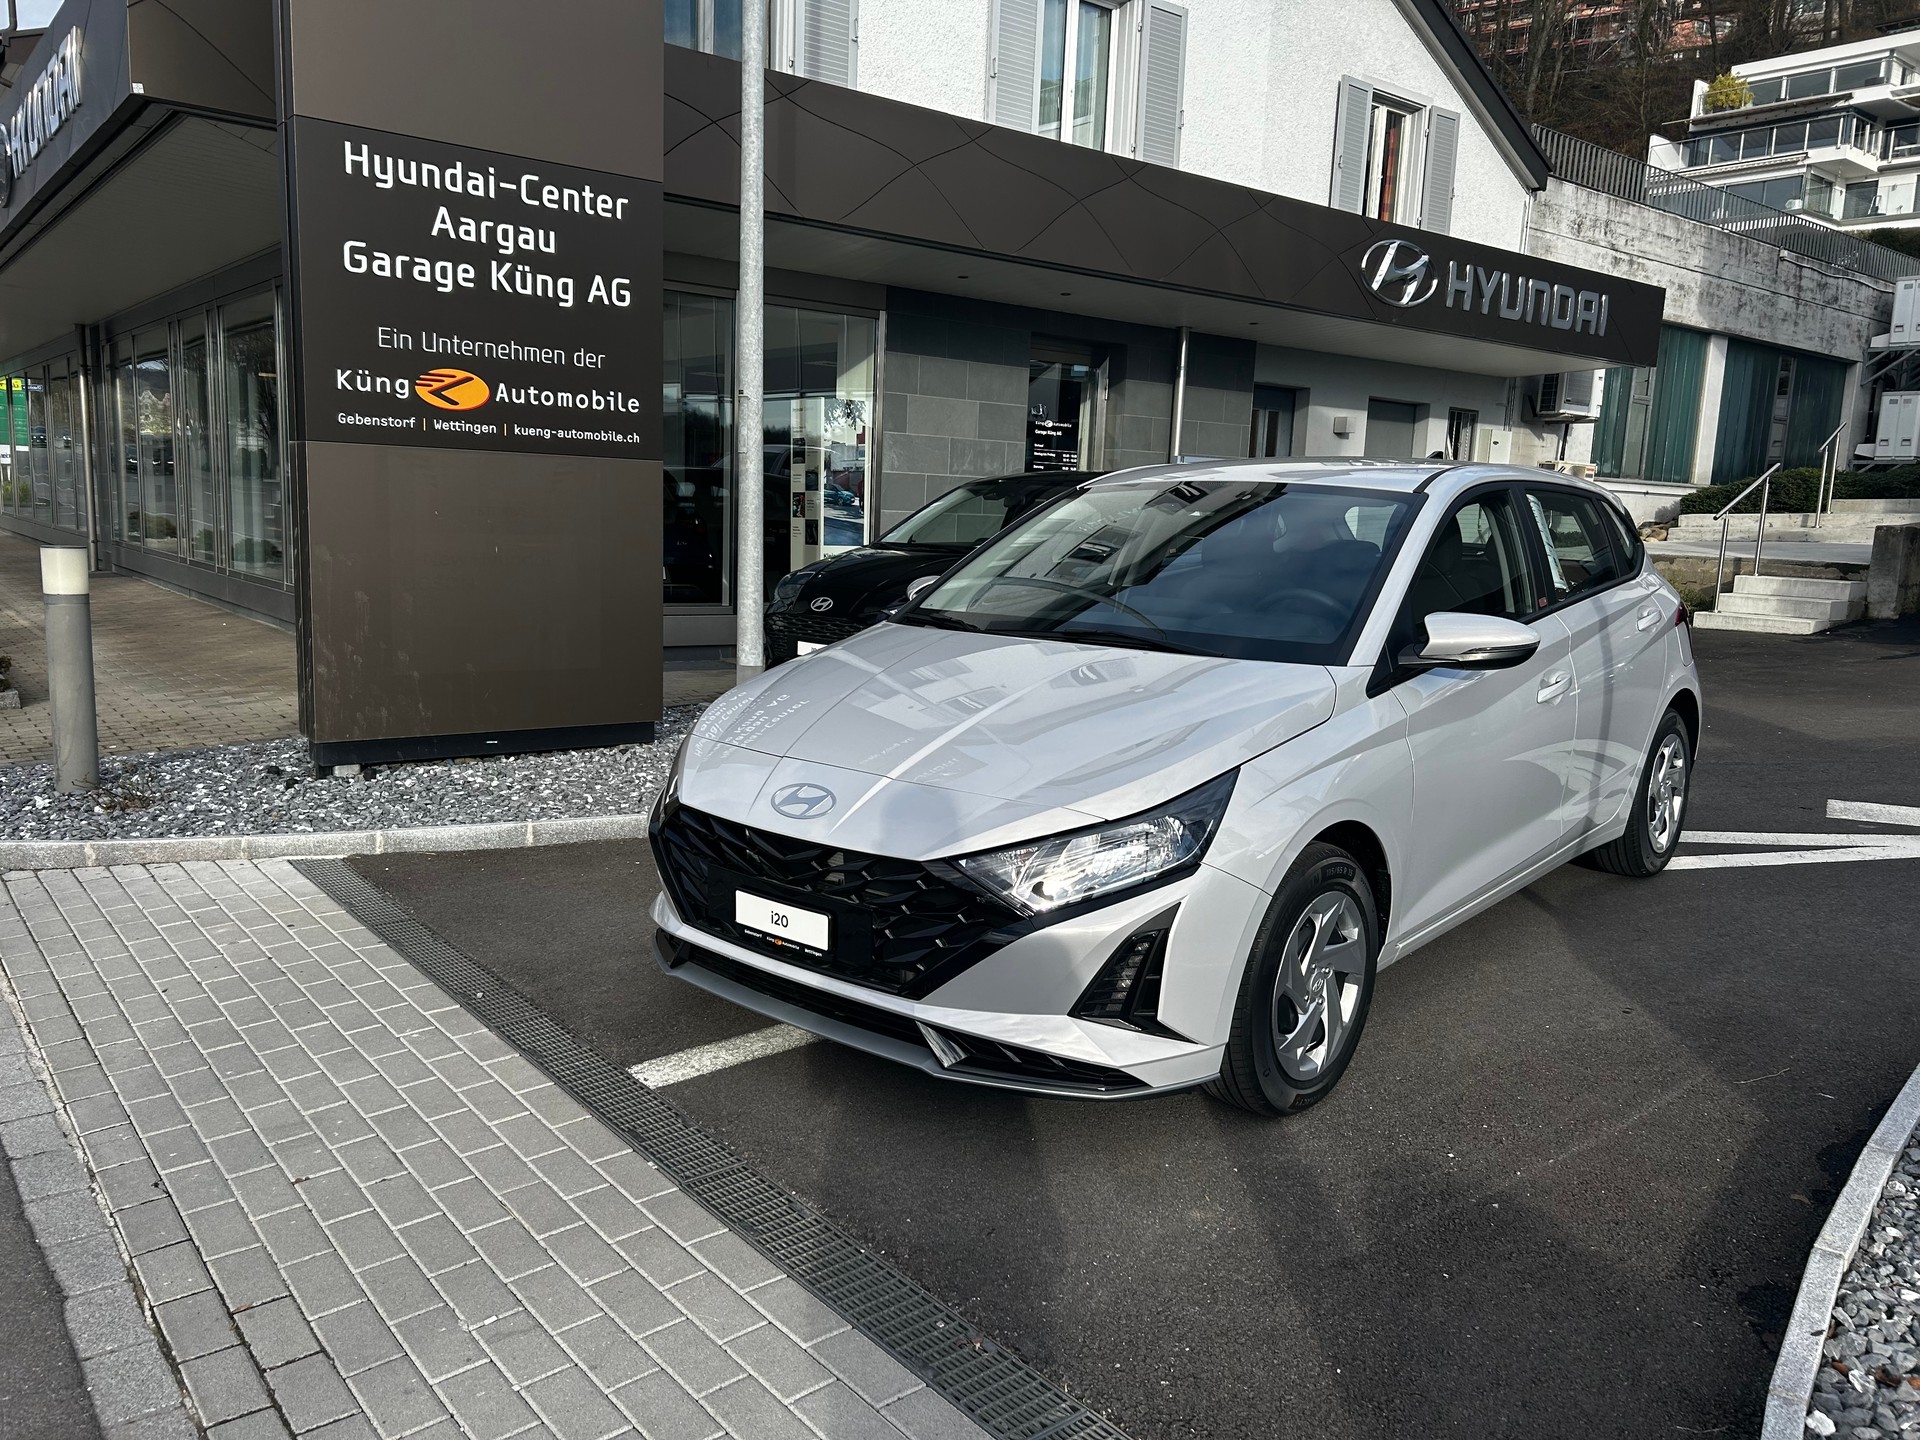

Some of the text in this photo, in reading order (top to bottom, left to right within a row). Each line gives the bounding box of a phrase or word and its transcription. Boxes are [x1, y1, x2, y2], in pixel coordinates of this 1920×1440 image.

[10, 25, 82, 179] HYUNDAI
[344, 141, 629, 220] Hyundai-Center
[430, 205, 556, 255] Aargau
[343, 240, 632, 308] Garage Küng AG
[1446, 260, 1609, 337] HYUNDAI
[377, 326, 606, 369] Ein Unternehmen der
[336, 368, 640, 414] Küng Automobile
[337, 412, 641, 444] Gebenstorf Wettingen kueng-automobile.ch
[770, 910, 789, 929] i20
